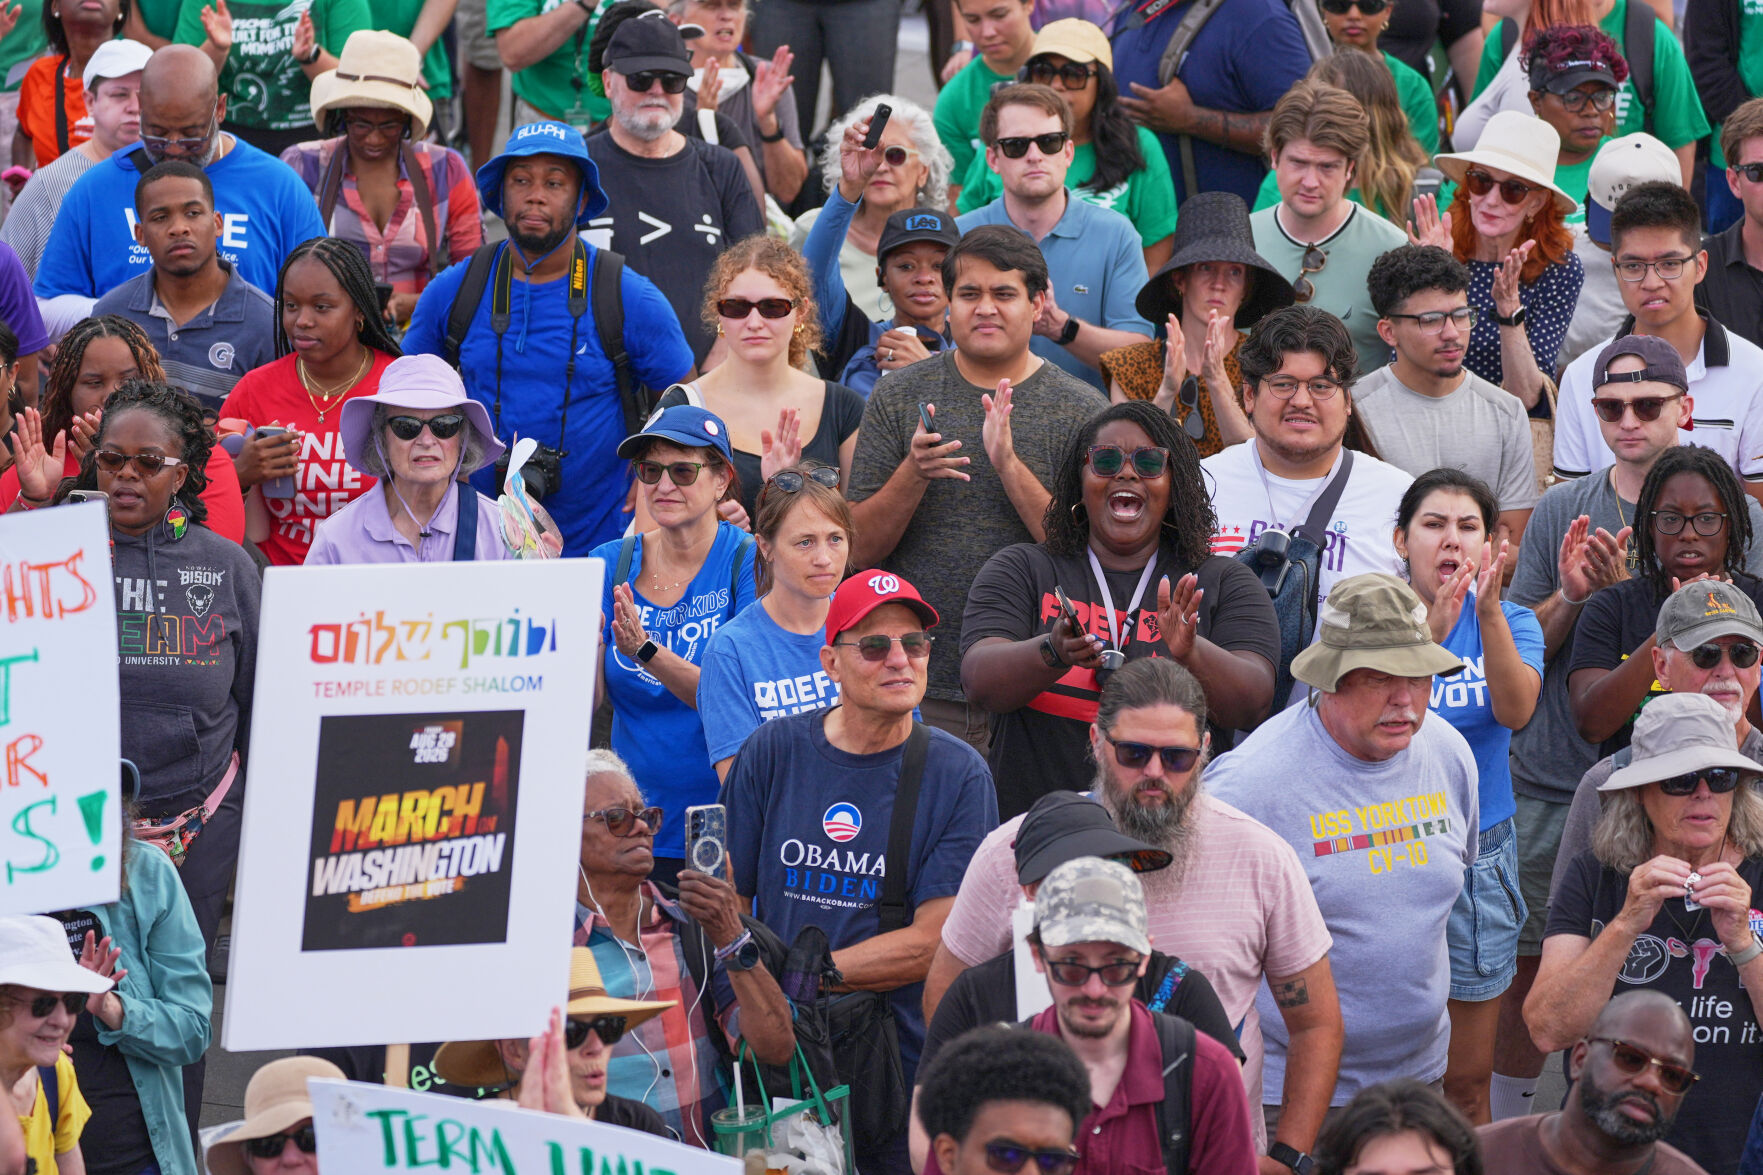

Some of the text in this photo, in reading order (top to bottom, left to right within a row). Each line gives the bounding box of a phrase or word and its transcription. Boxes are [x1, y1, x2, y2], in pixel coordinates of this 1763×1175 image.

[231, 29, 258, 43] UILT
[517, 124, 566, 141] BLU-PHI
[911, 217, 937, 229] Lee
[573, 258, 584, 290] Nikon
[208, 342, 235, 370] G
[0, 548, 97, 622] HTS
[178, 568, 225, 587] BISON
[688, 588, 730, 618] KIDS
[117, 612, 226, 656] EAM
[125, 656, 180, 666] UNIVERSITY
[313, 675, 543, 698] TEMPLE RODEF SHALOM
[1429, 680, 1488, 709] VOT
[330, 781, 486, 853] MARCH
[1310, 790, 1448, 839] USS YORKTOWN
[312, 832, 507, 897] WASHINGTON
[780, 838, 886, 878] OBAMA
[1368, 841, 1429, 875] CV-10
[785, 867, 878, 900] BIDEN
[1690, 995, 1733, 1018] life
[1693, 1025, 1730, 1044] on
[366, 1109, 516, 1175] TERM
